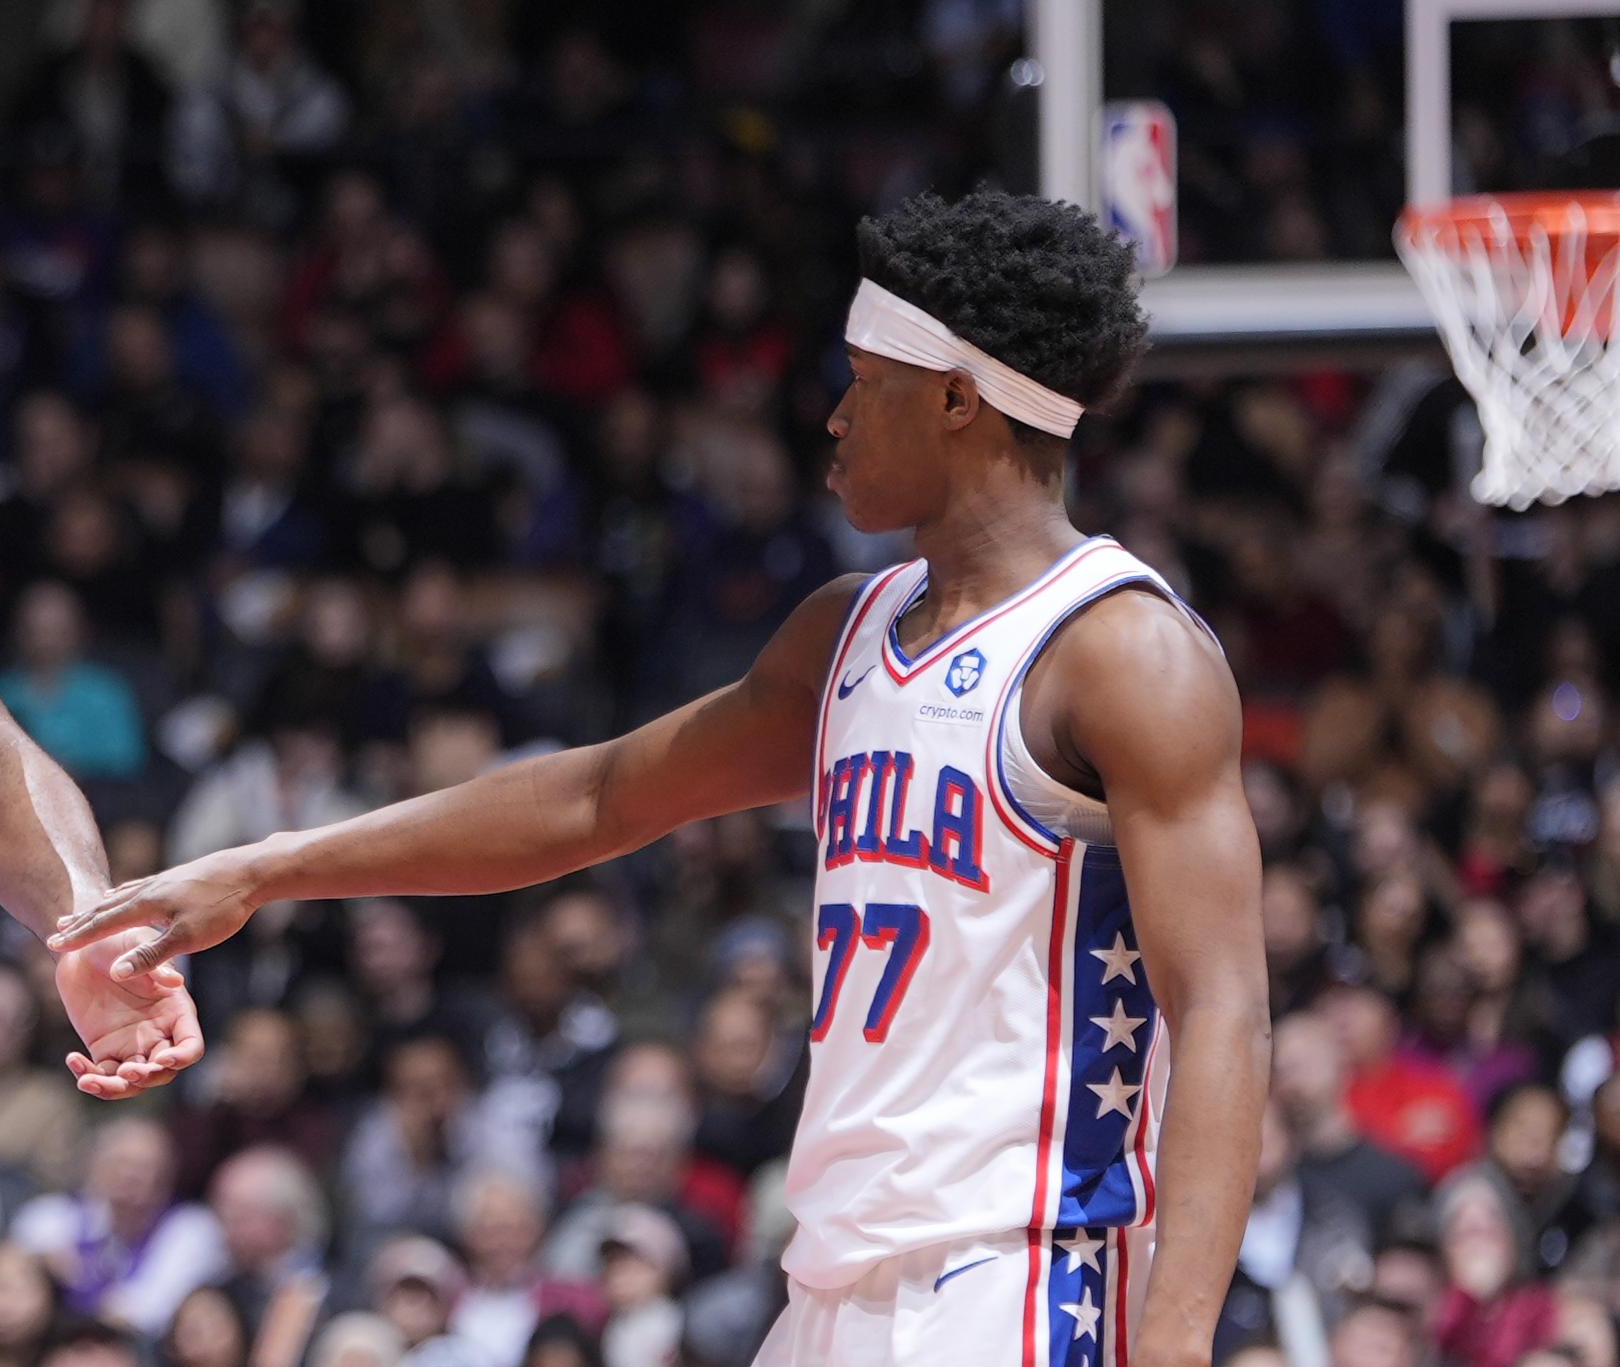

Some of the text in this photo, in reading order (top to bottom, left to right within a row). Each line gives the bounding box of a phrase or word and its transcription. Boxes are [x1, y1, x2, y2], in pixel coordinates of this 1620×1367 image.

[919, 704, 984, 722] crypto.com
[824, 750, 991, 894] HILA
[811, 903, 930, 1044] 77
